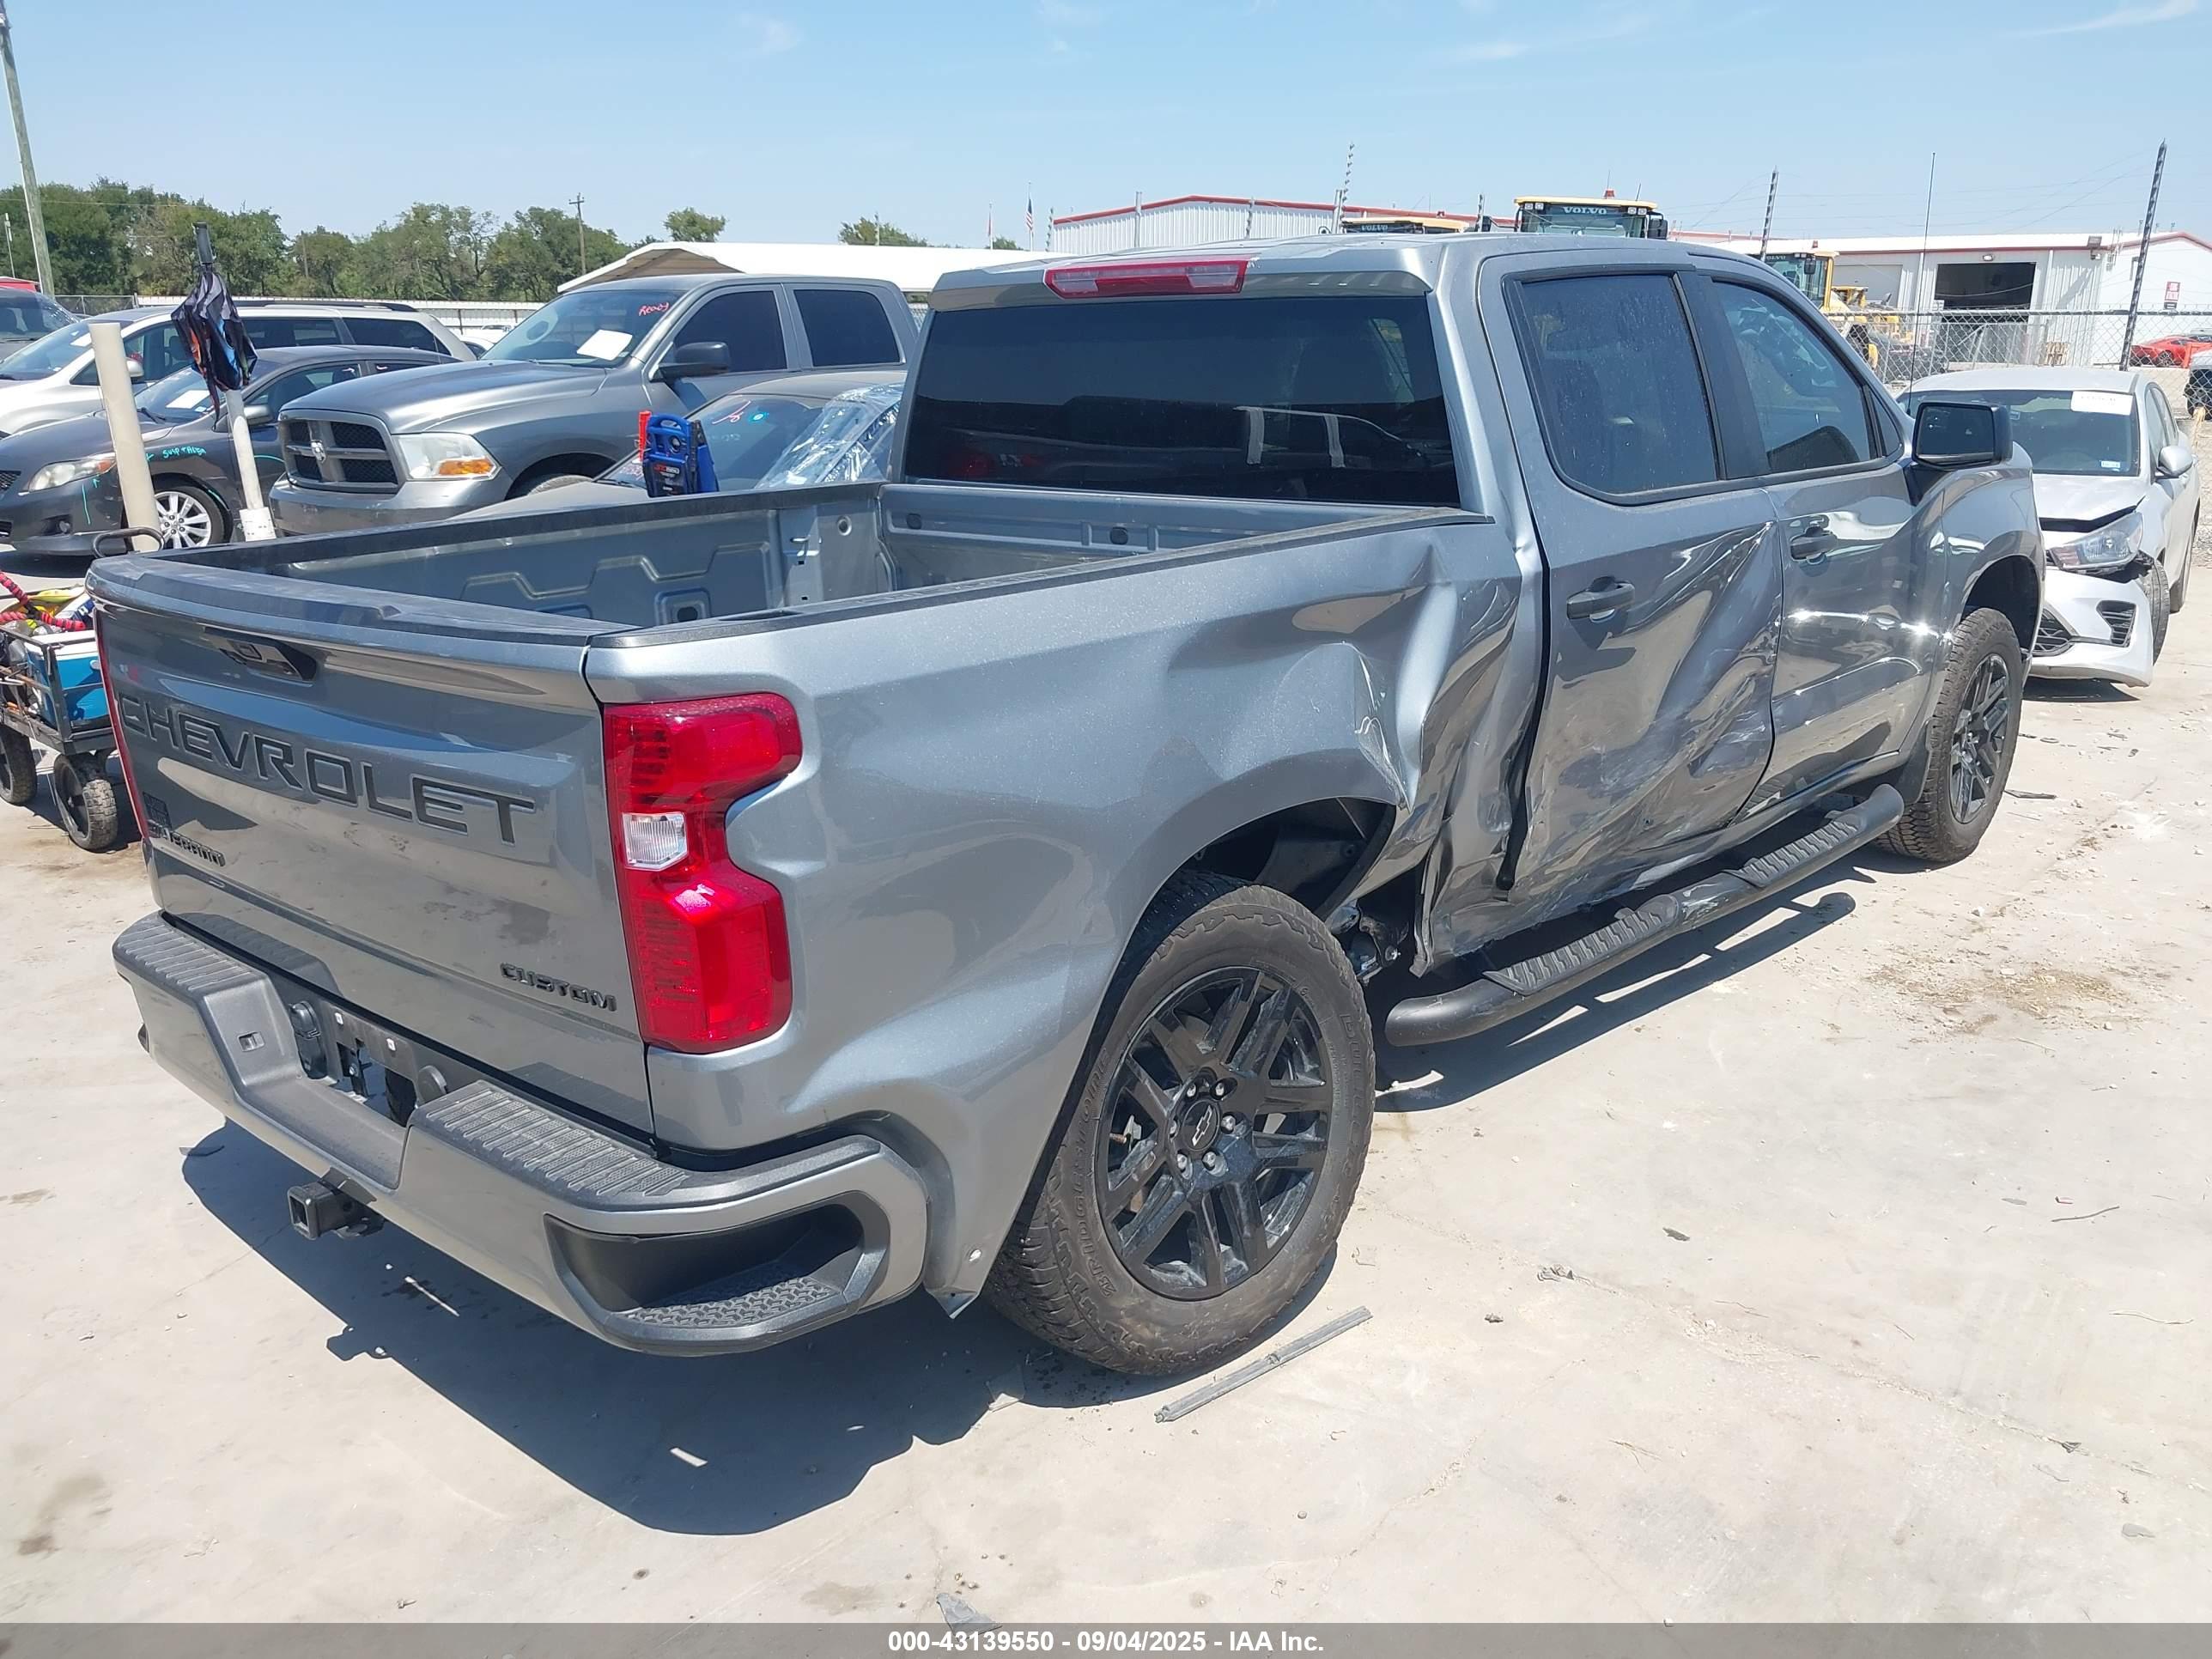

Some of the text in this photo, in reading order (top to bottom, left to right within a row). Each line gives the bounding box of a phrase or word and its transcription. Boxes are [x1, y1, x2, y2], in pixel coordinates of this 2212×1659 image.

[1563, 206, 1607, 215] VOLVO
[118, 691, 536, 846] CHEVROLET
[500, 962, 617, 1012] CUSTOM
